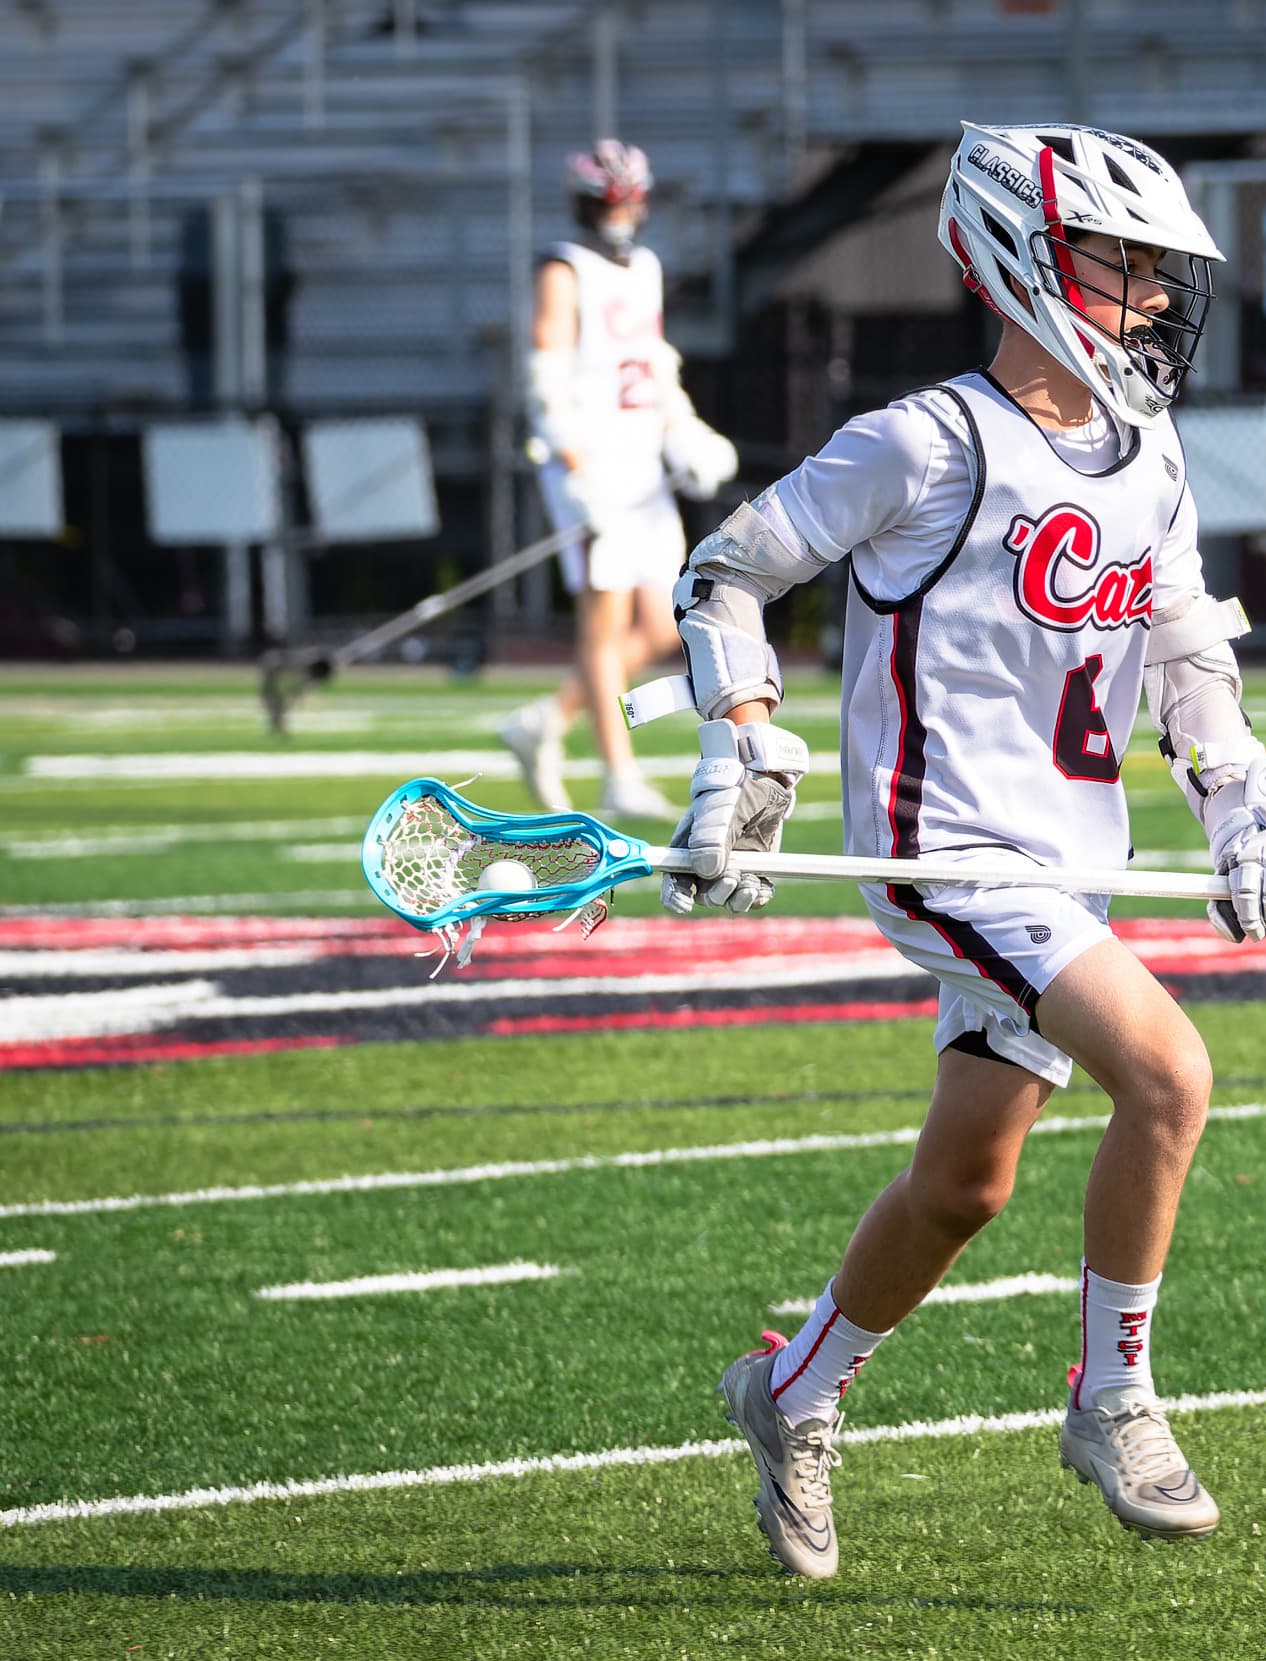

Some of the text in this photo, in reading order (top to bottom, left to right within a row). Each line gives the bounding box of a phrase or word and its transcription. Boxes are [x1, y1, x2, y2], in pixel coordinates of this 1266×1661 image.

[968, 144, 1044, 209] CLASSICS
[1002, 502, 1152, 633] 'Cat
[1053, 653, 1120, 784] 6
